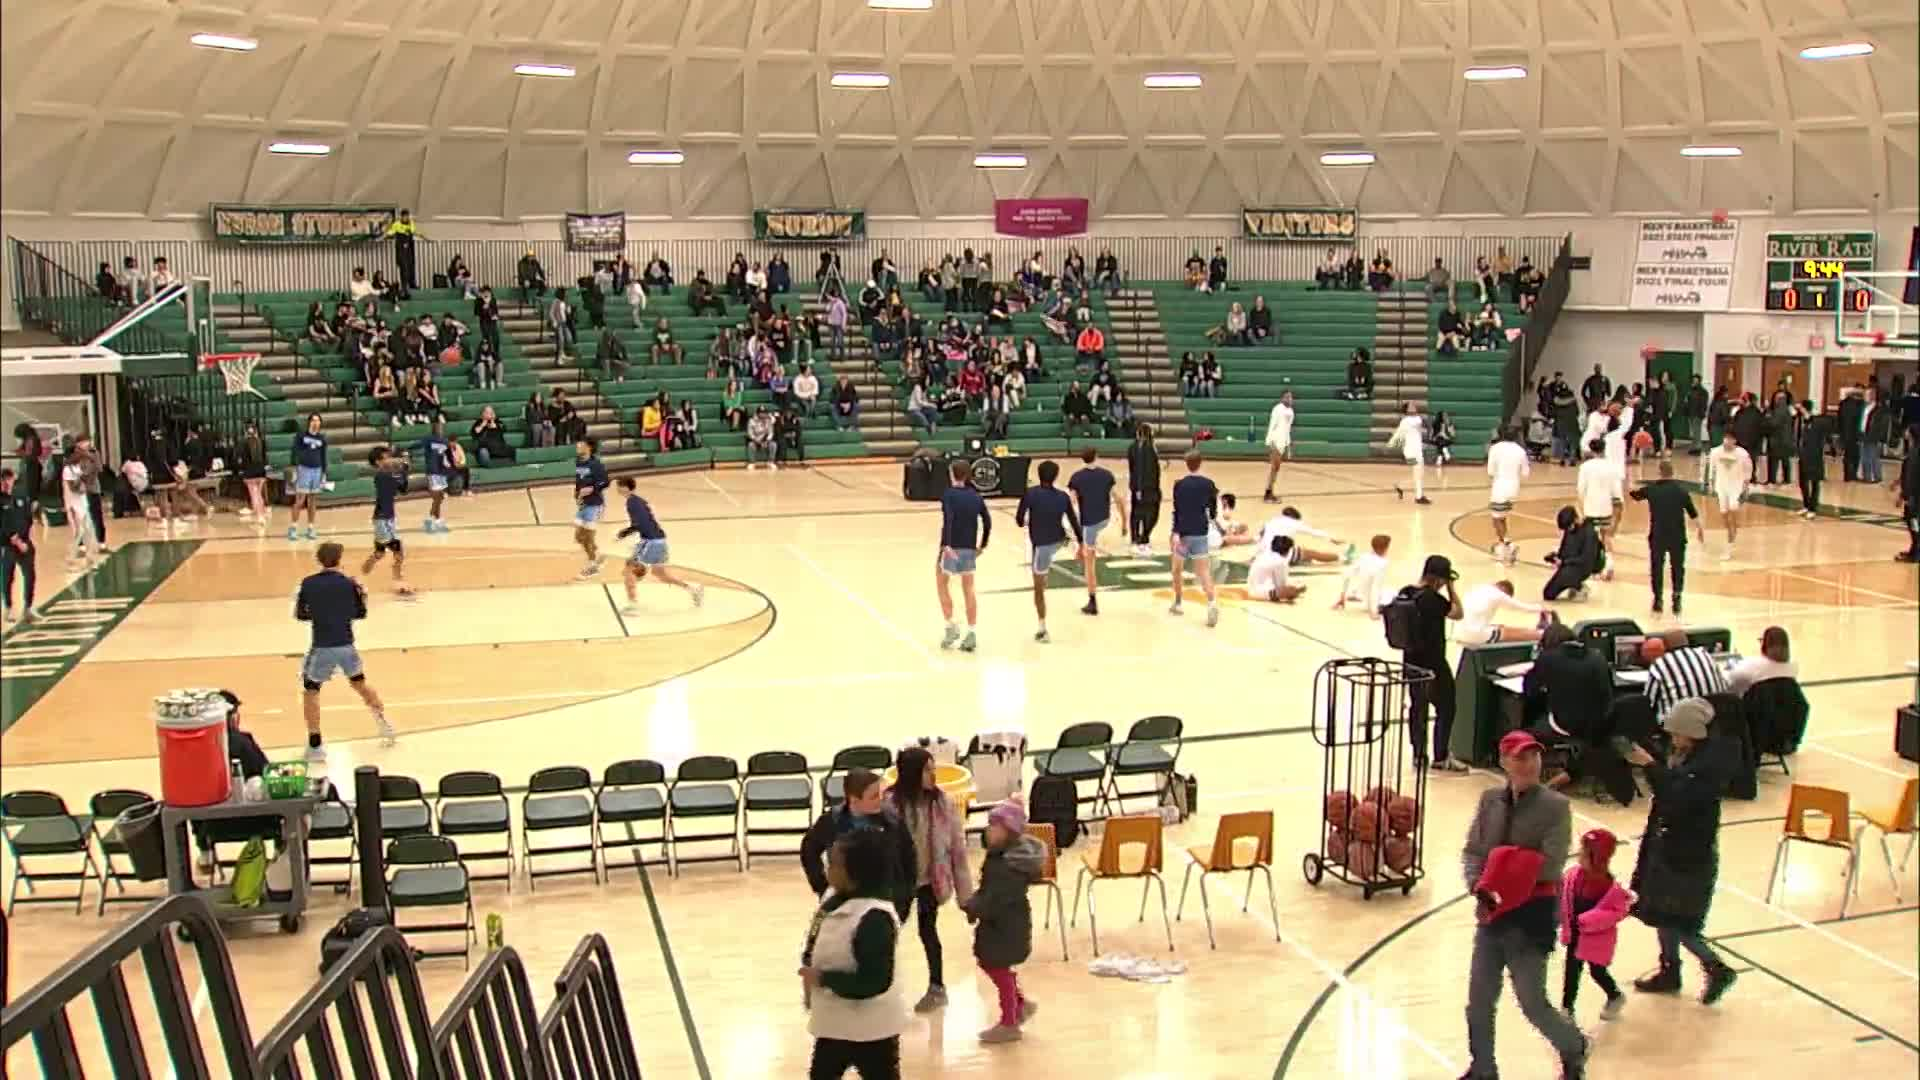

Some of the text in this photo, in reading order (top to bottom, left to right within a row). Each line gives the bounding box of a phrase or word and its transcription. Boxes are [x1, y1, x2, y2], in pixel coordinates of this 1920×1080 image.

[1769, 240, 1873, 257] RIVER RATS
[1804, 259, 1844, 278] 9:44
[1663, 277, 1695, 286] FINAL
[1697, 277, 1728, 286] FOUR
[1784, 287, 1797, 310] 0
[1816, 292, 1823, 308] 1
[1855, 289, 1869, 311] 0
